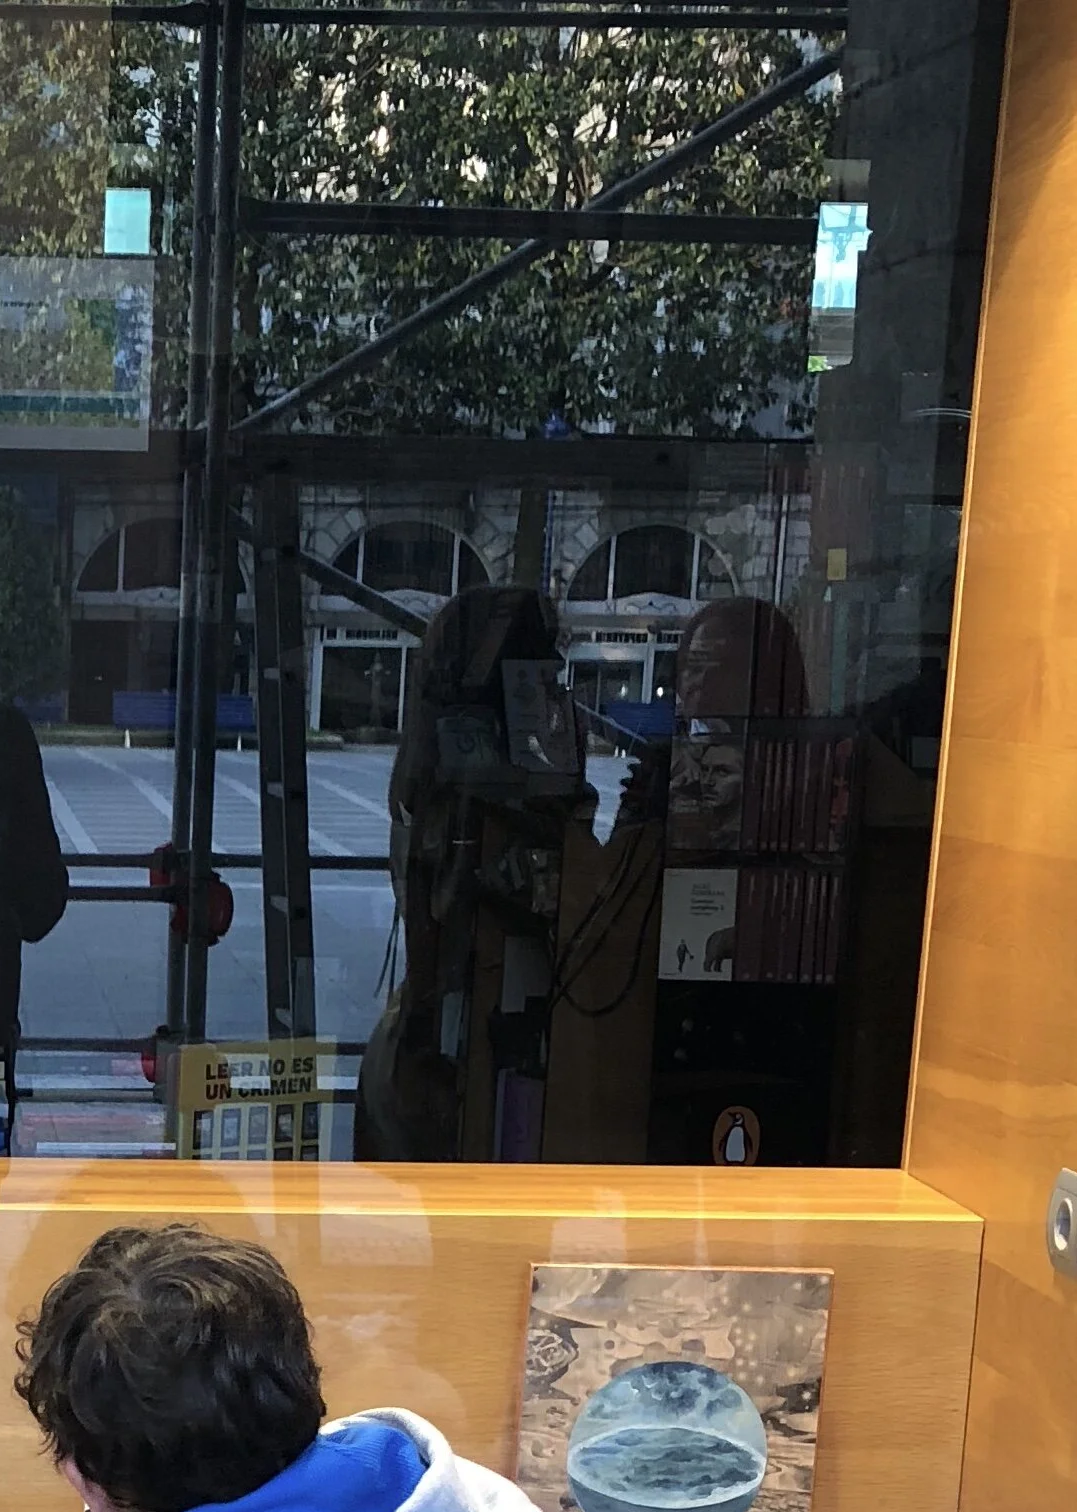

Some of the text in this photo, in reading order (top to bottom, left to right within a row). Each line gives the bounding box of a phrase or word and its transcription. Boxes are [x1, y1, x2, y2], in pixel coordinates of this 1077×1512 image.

[205, 1057, 314, 1080] LEER NO ES
[205, 1077, 311, 1100] UN CRIMEN
